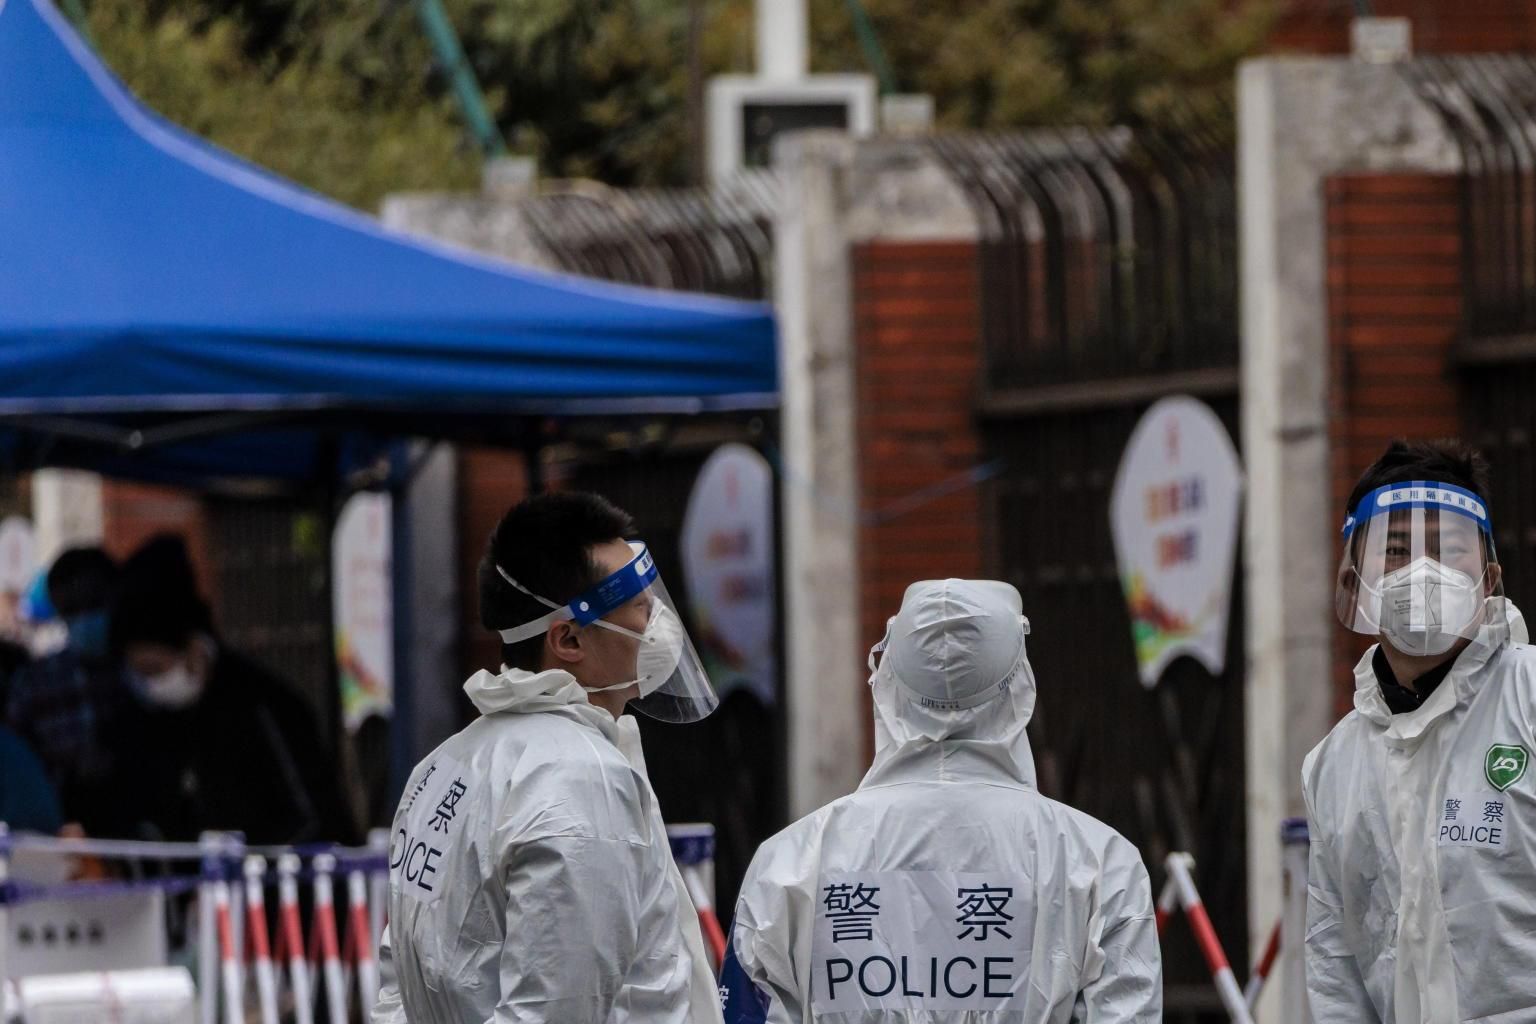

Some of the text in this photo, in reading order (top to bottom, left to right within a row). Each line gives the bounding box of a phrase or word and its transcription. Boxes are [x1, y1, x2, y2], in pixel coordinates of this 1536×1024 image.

[1444, 798, 1504, 824] 警察
[1439, 825, 1502, 845] POLICE
[823, 882, 1014, 943] 警察
[826, 955, 1015, 1000] POLICE
